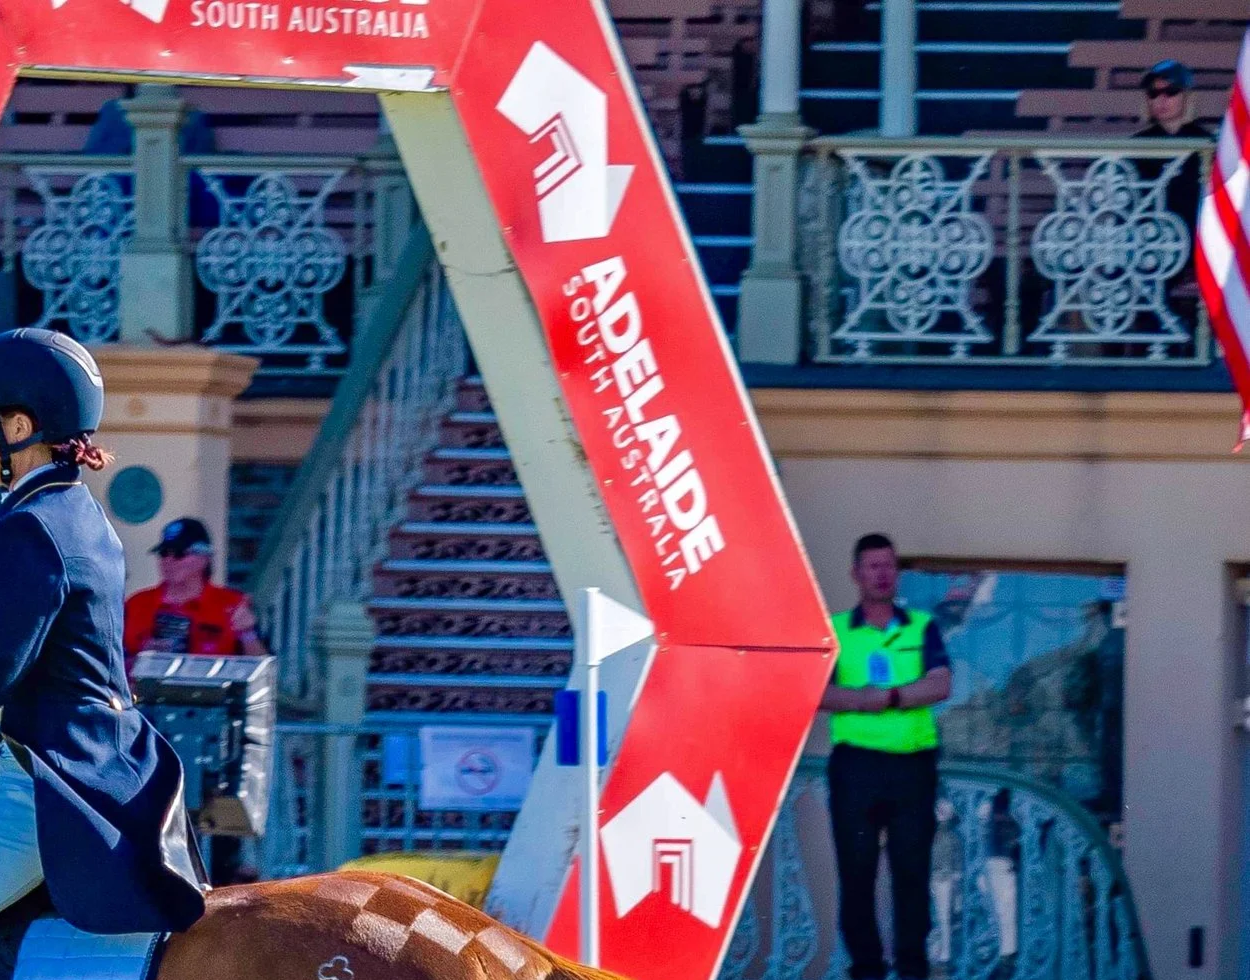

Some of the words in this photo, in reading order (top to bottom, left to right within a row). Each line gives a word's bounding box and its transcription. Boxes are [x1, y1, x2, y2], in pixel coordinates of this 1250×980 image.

[190, 0, 279, 30] SOUTH
[288, 6, 430, 39] AUSTRALIA
[562, 275, 614, 394] SOUTH
[602, 405, 688, 592] AUSTRALIA
[581, 255, 727, 575] ADELAIDE
